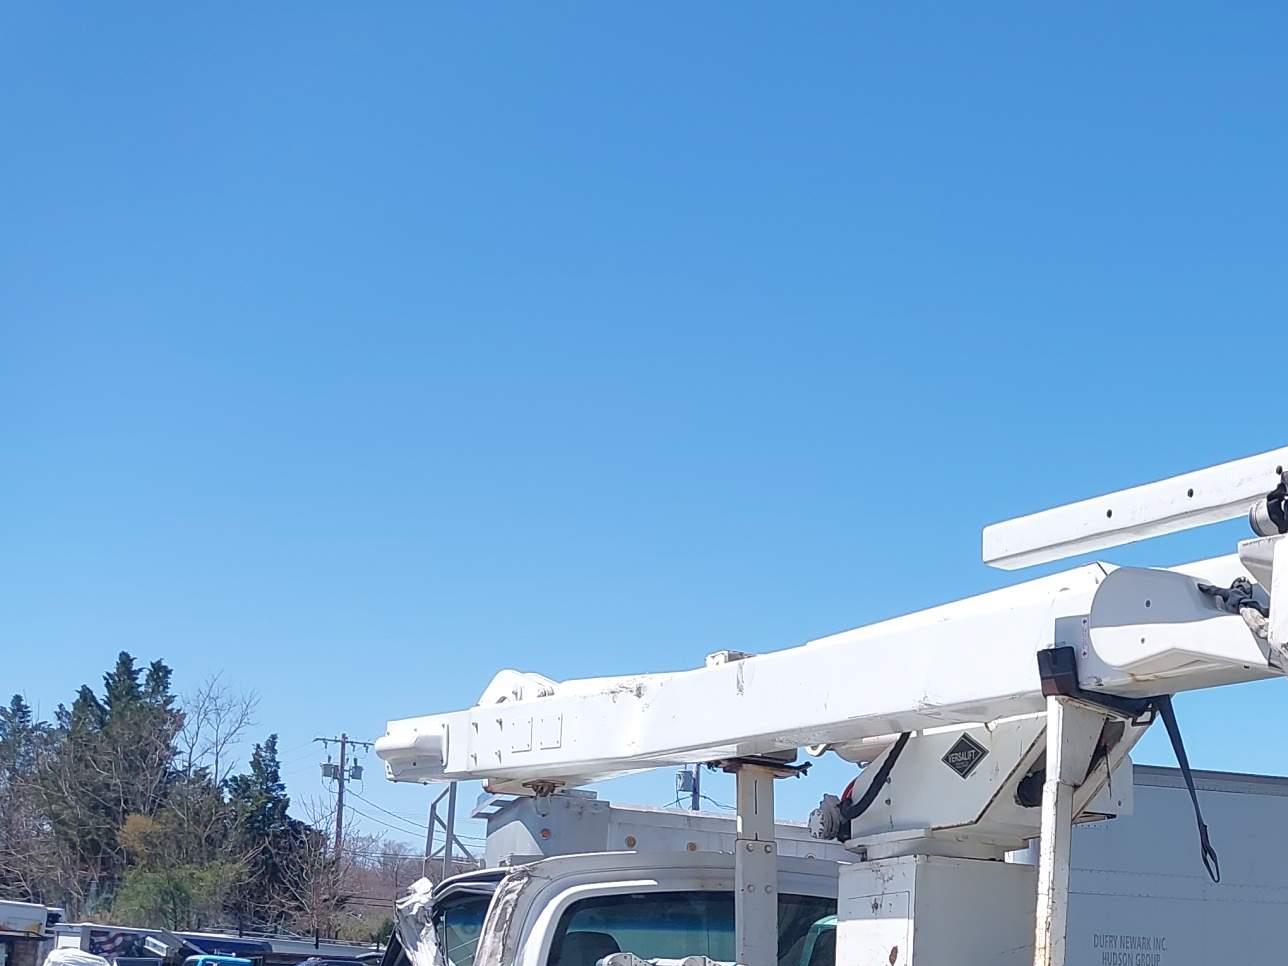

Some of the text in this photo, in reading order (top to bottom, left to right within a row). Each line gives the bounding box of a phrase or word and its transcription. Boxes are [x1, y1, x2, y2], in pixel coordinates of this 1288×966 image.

[1093, 934, 1118, 949] DUFRY
[1119, 935, 1152, 951] NEWARK
[1102, 951, 1133, 966] HUDSON
